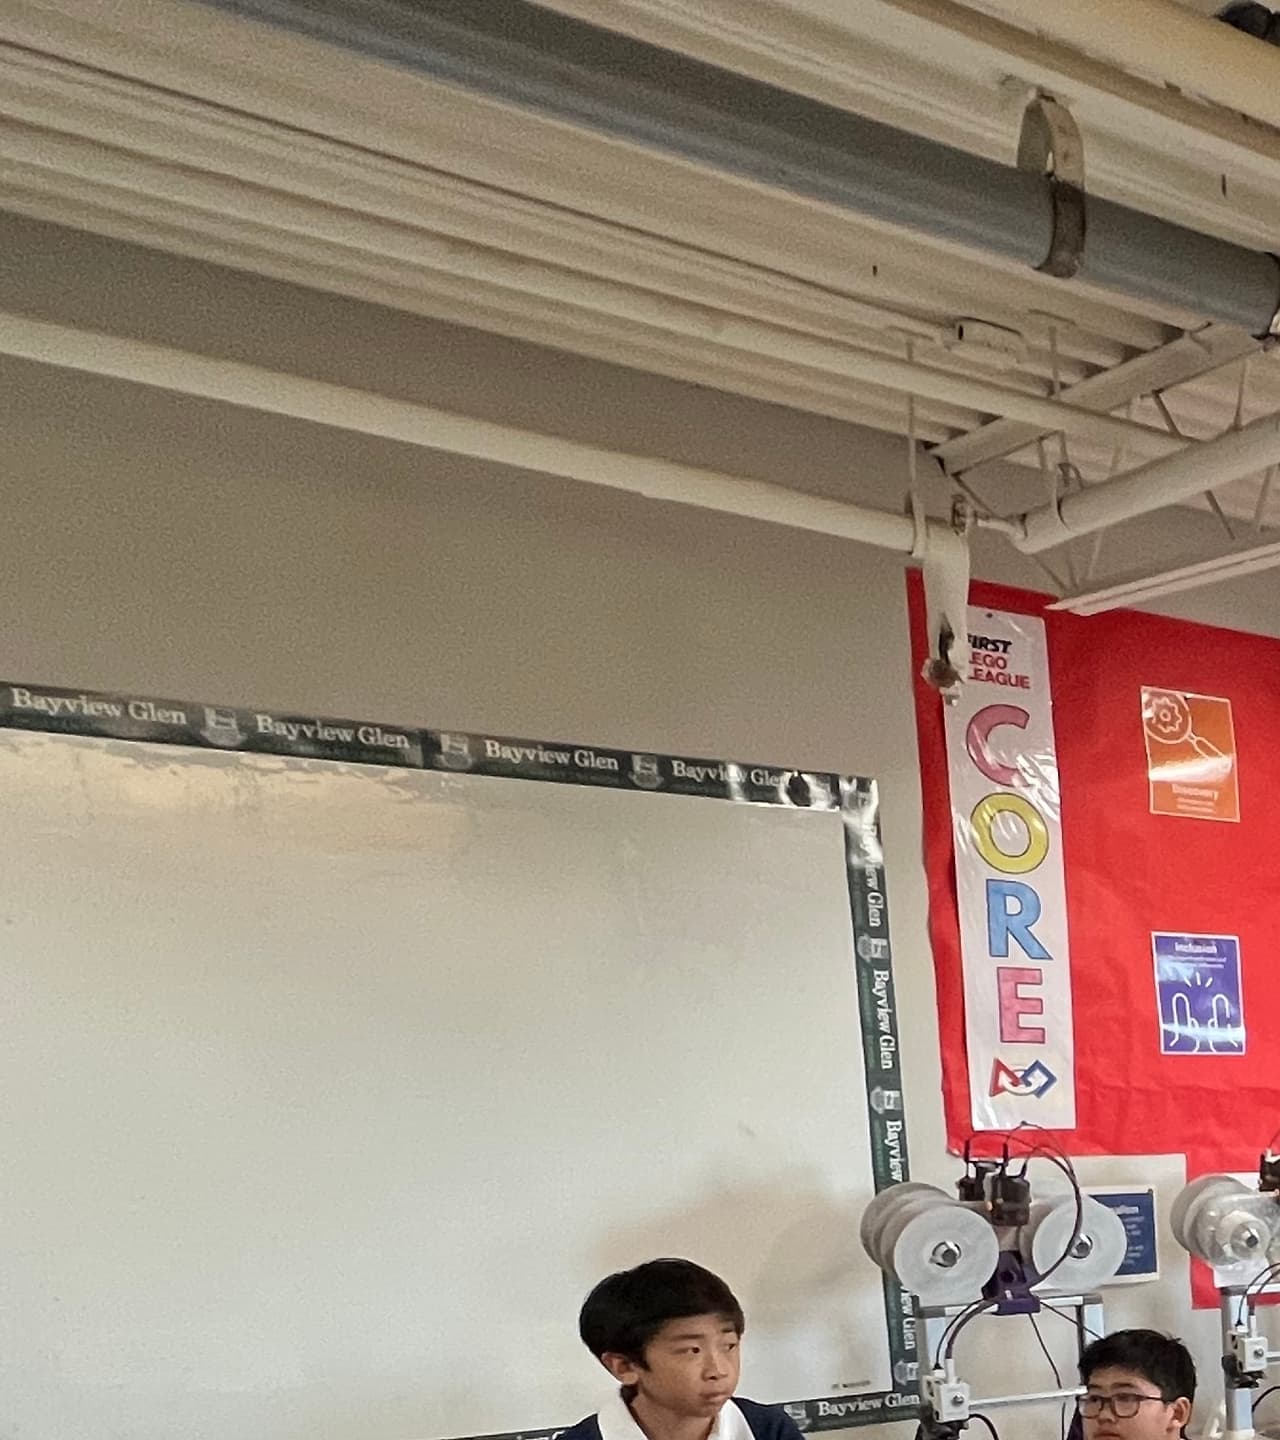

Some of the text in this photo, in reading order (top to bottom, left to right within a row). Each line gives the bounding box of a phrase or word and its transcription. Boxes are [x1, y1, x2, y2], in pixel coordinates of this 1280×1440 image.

[11, 687, 187, 725] Bayview Glen
[256, 714, 410, 749] Bayview Glen
[484, 740, 619, 771] Bayview Glen
[672, 760, 789, 787] Bayviw Gle
[966, 703, 1053, 1044] CORE
[866, 891, 884, 927] Glen
[872, 969, 898, 1069] Bayview Glen
[885, 1120, 903, 1183] Bayview
[903, 1318, 916, 1350] Glen
[818, 1393, 920, 1418] Bayview Glen
